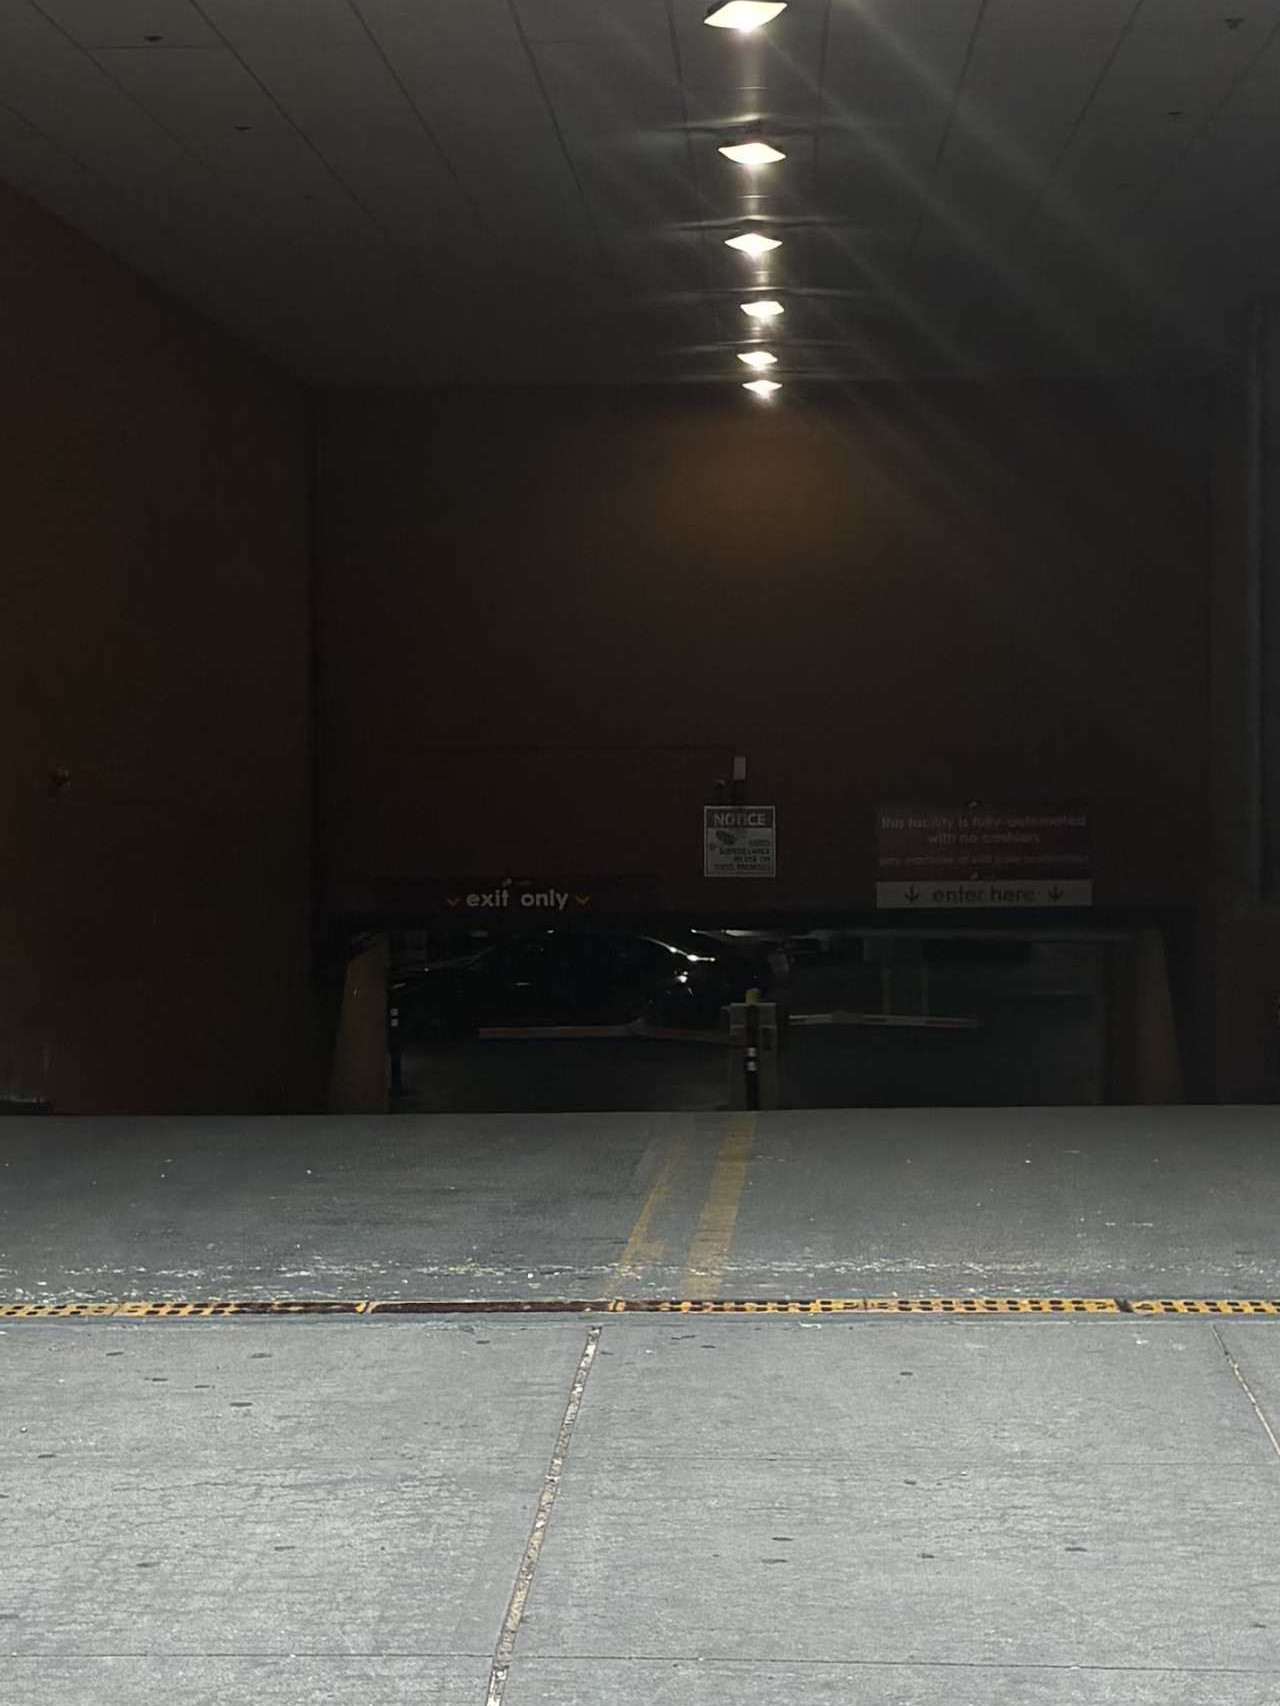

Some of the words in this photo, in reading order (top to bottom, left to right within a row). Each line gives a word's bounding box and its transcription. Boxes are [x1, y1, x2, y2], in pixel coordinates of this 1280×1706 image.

[713, 812, 766, 826] NOTICE
[881, 816, 904, 828] this
[908, 816, 954, 830] facility
[929, 832, 956, 843] with
[959, 834, 978, 843] no
[466, 889, 509, 907] exit
[520, 889, 569, 910] only
[932, 886, 984, 903] enter
[990, 886, 1036, 902] here
